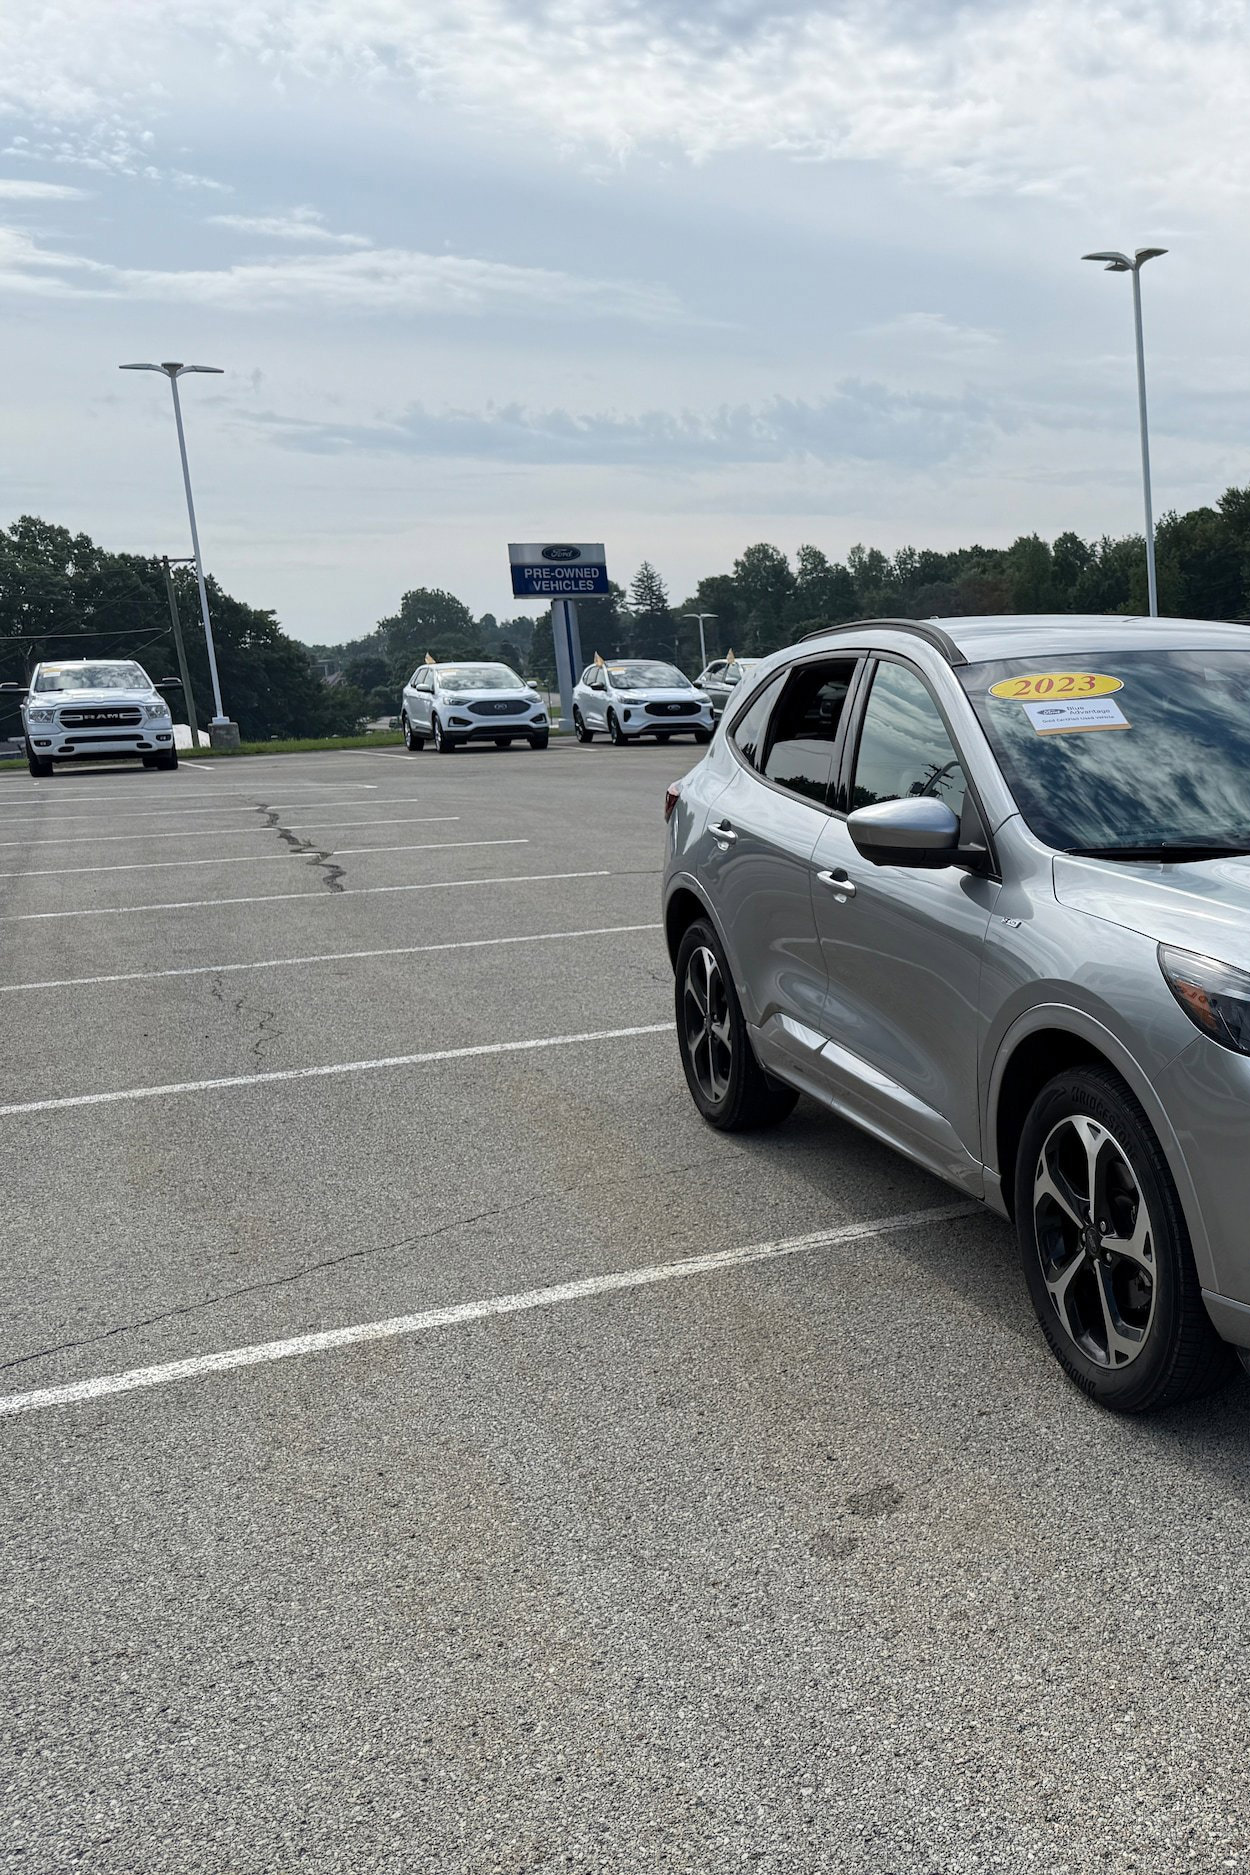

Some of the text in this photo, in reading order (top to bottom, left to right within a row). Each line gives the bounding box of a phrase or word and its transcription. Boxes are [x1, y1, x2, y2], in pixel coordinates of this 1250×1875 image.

[550, 548, 573, 558] Ford
[524, 567, 600, 579] PRE-OWNED
[533, 580, 595, 591] VEHICLES
[1012, 675, 1096, 697] 2023
